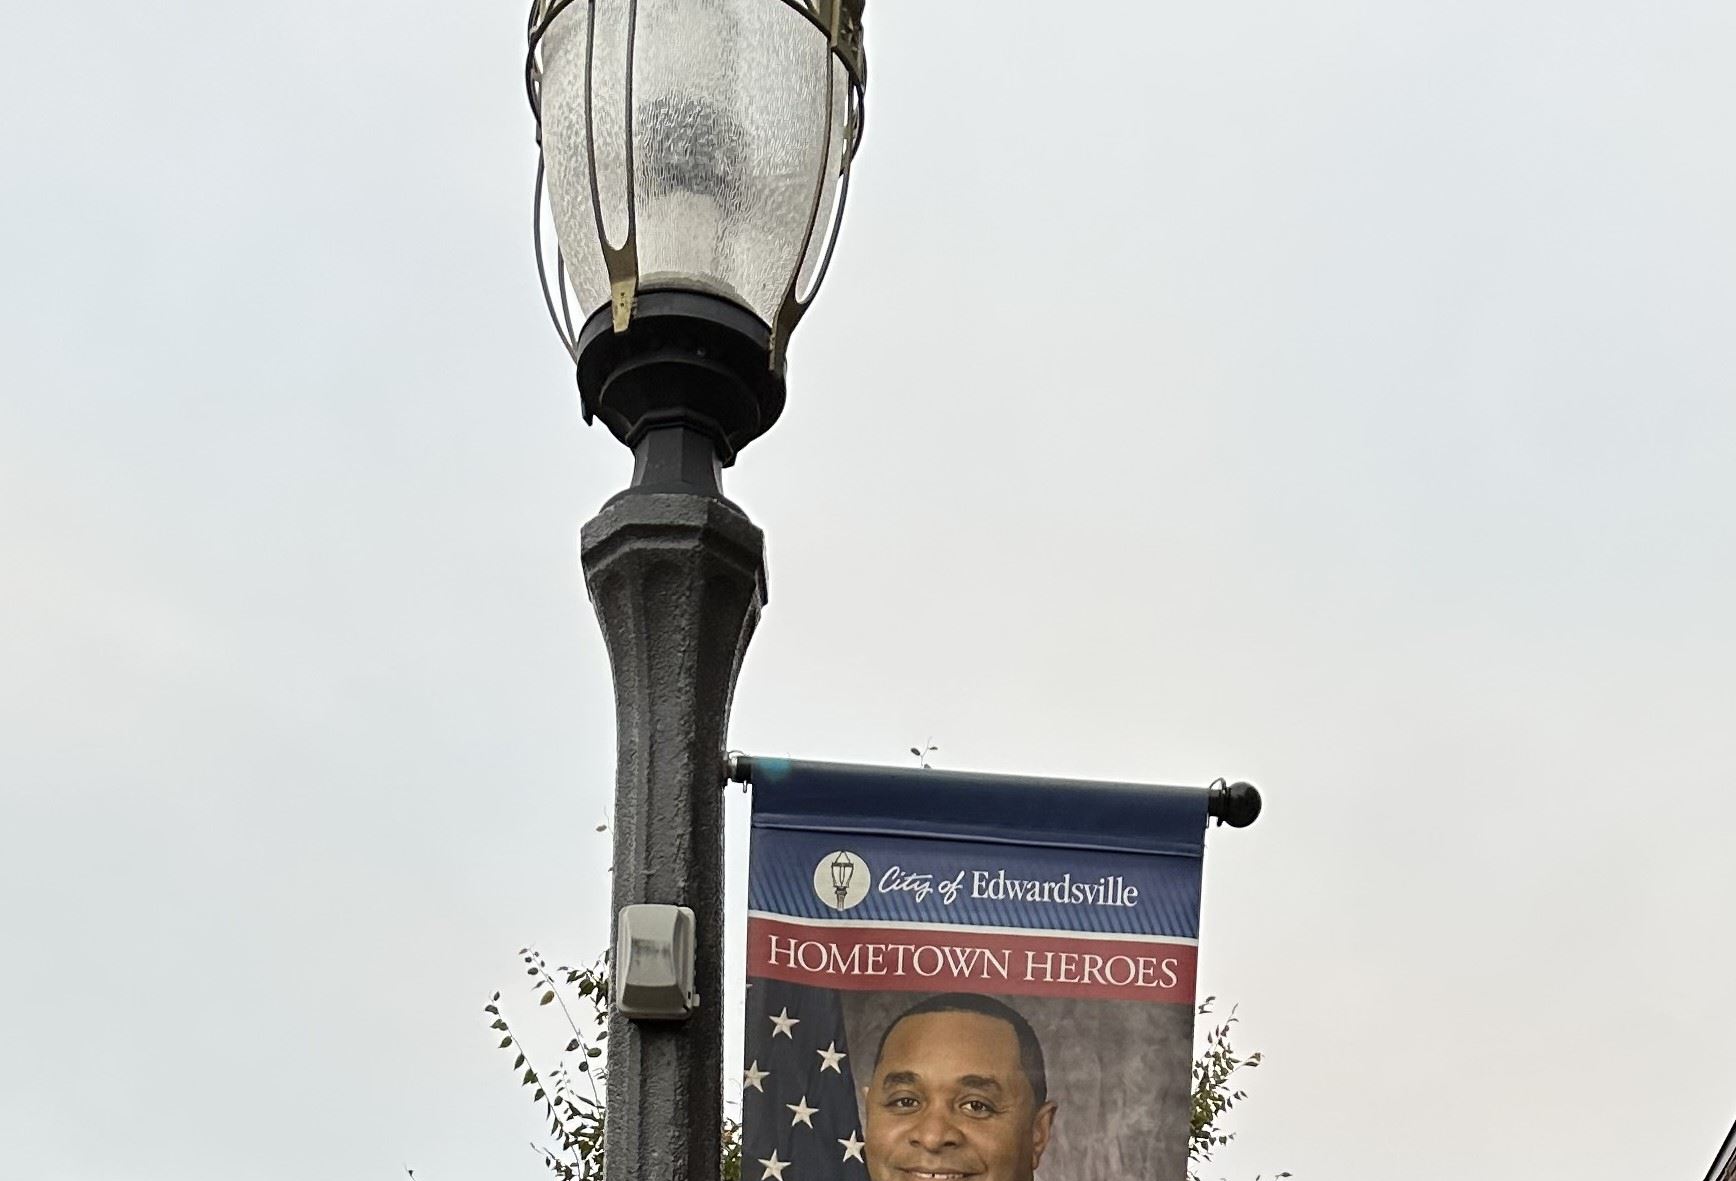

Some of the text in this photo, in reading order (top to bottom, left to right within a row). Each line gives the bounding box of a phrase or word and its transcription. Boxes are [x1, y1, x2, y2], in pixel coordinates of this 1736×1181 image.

[878, 866, 1139, 907] City of Edwardsville
[768, 935, 1178, 988] HOMETOWN HEROES
